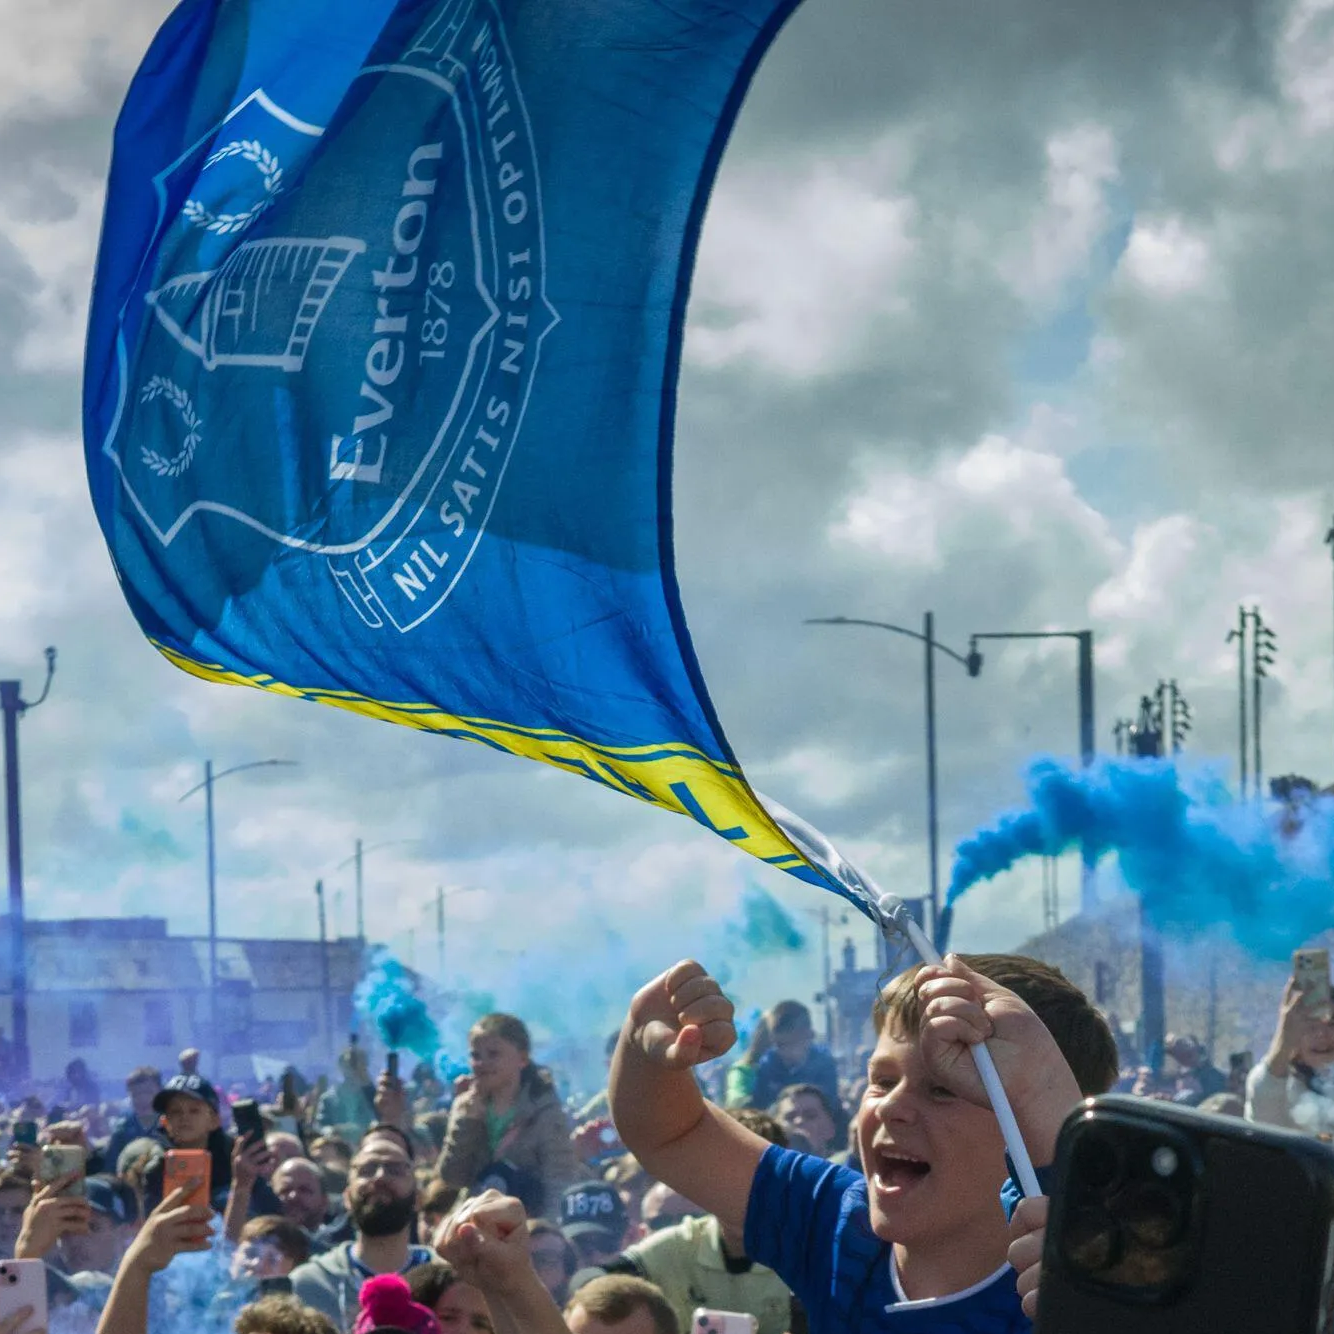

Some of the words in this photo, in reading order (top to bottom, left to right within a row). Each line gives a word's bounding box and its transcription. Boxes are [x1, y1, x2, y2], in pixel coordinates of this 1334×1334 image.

[329, 141, 443, 484] Everton
[392, 539, 449, 602] NIL
[440, 395, 510, 538] SATIS
[499, 248, 531, 374] NISI
[419, 260, 456, 366] 1878
